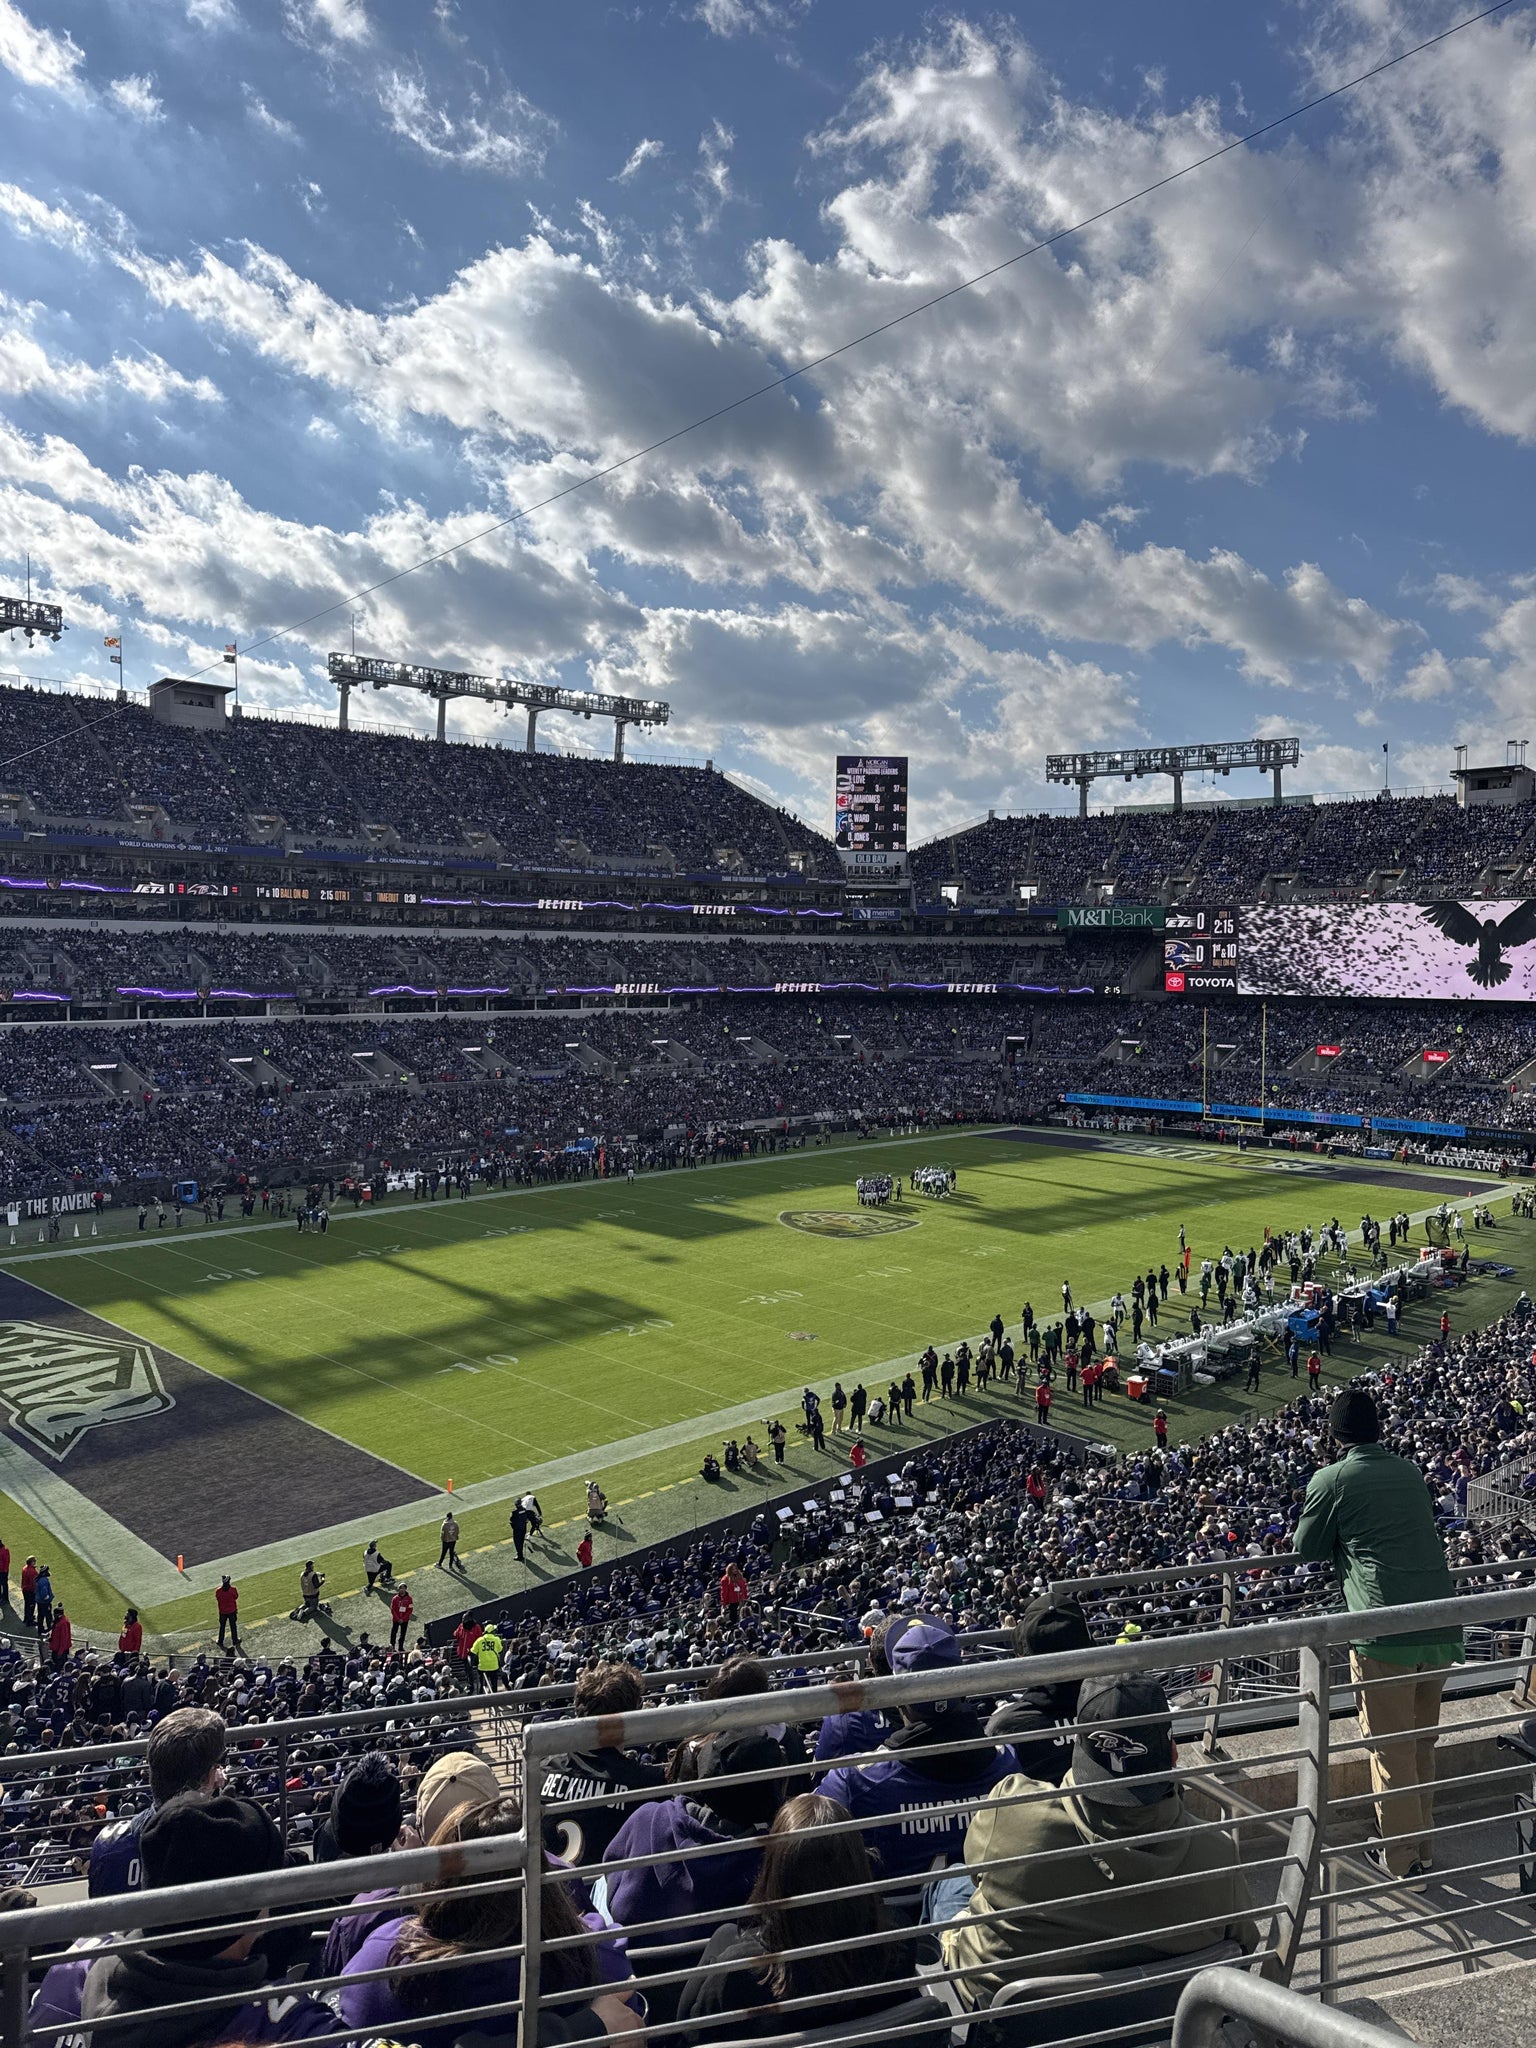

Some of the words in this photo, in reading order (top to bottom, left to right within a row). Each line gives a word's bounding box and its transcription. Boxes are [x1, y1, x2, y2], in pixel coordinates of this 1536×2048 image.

[853, 775, 866, 784] LOVE
[893, 784, 900, 792] 37
[854, 795, 880, 803] MAHOMES
[854, 814, 870, 823] WARD
[893, 823, 899, 831] 31
[854, 833, 869, 842] JONES
[133, 882, 165, 894] JETS
[169, 883, 174, 894] 0
[223, 885, 228, 896] 0
[272, 888, 279, 898] 10
[280, 888, 293, 899] BALL
[293, 889, 301, 899] ON
[301, 889, 309, 899] 40
[320, 890, 333, 900] 2:15
[334, 890, 346, 900] QTR
[376, 893, 399, 903] TIMEOUT
[538, 899, 584, 910] DECIBEL
[692, 905, 736, 915] DECIBEL
[1067, 909, 1110, 926] M&T
[1112, 909, 1153, 926] Bank
[1197, 912, 1204, 930] 0
[1214, 919, 1234, 934] 2:15
[1196, 945, 1204, 962] 0
[1227, 944, 1237, 958] 10
[615, 983, 660, 994] DECIBEL
[774, 983, 821, 993] DECIBEL
[947, 983, 998, 994] DECIBEL
[1188, 977, 1235, 988] TOYOTA
[1104, 985, 1121, 994] 2:15
[26, 1198, 49, 1215] THE
[52, 1191, 97, 1213] RAVENS
[206, 1267, 264, 1282] 10
[747, 1289, 804, 1306] 30
[613, 1318, 675, 1338] 20
[448, 1353, 520, 1376] 10
[56, 1688, 69, 1703] 52
[541, 1774, 606, 1800] BECKHAM
